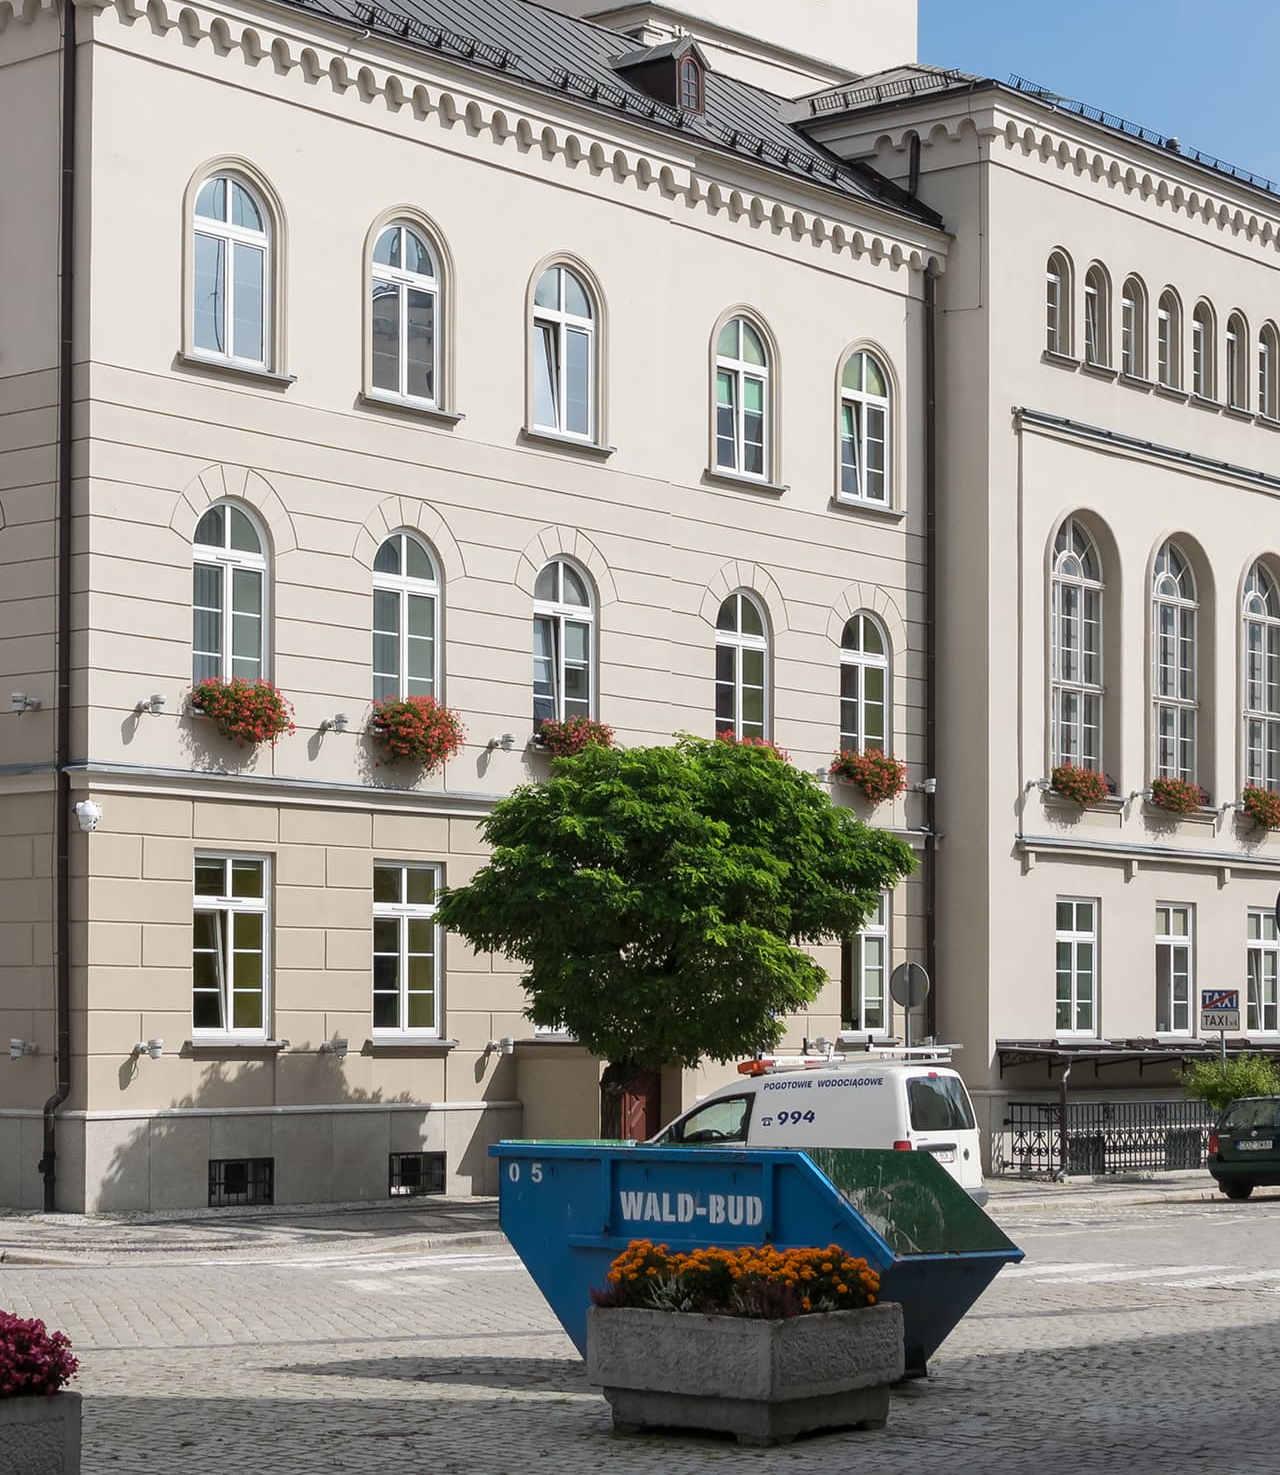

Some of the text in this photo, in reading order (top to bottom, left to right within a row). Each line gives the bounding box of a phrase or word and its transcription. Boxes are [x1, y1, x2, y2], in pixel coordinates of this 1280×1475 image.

[1203, 992, 1237, 1008] TAXI
[1204, 1015, 1228, 1026] TAXI
[763, 1077, 884, 1091] POGOTOWIE WODOCIĄGOWE
[777, 1110, 816, 1125] 994
[508, 1163, 543, 1183] 0 5
[619, 1190, 763, 1226] WALD-BUD
